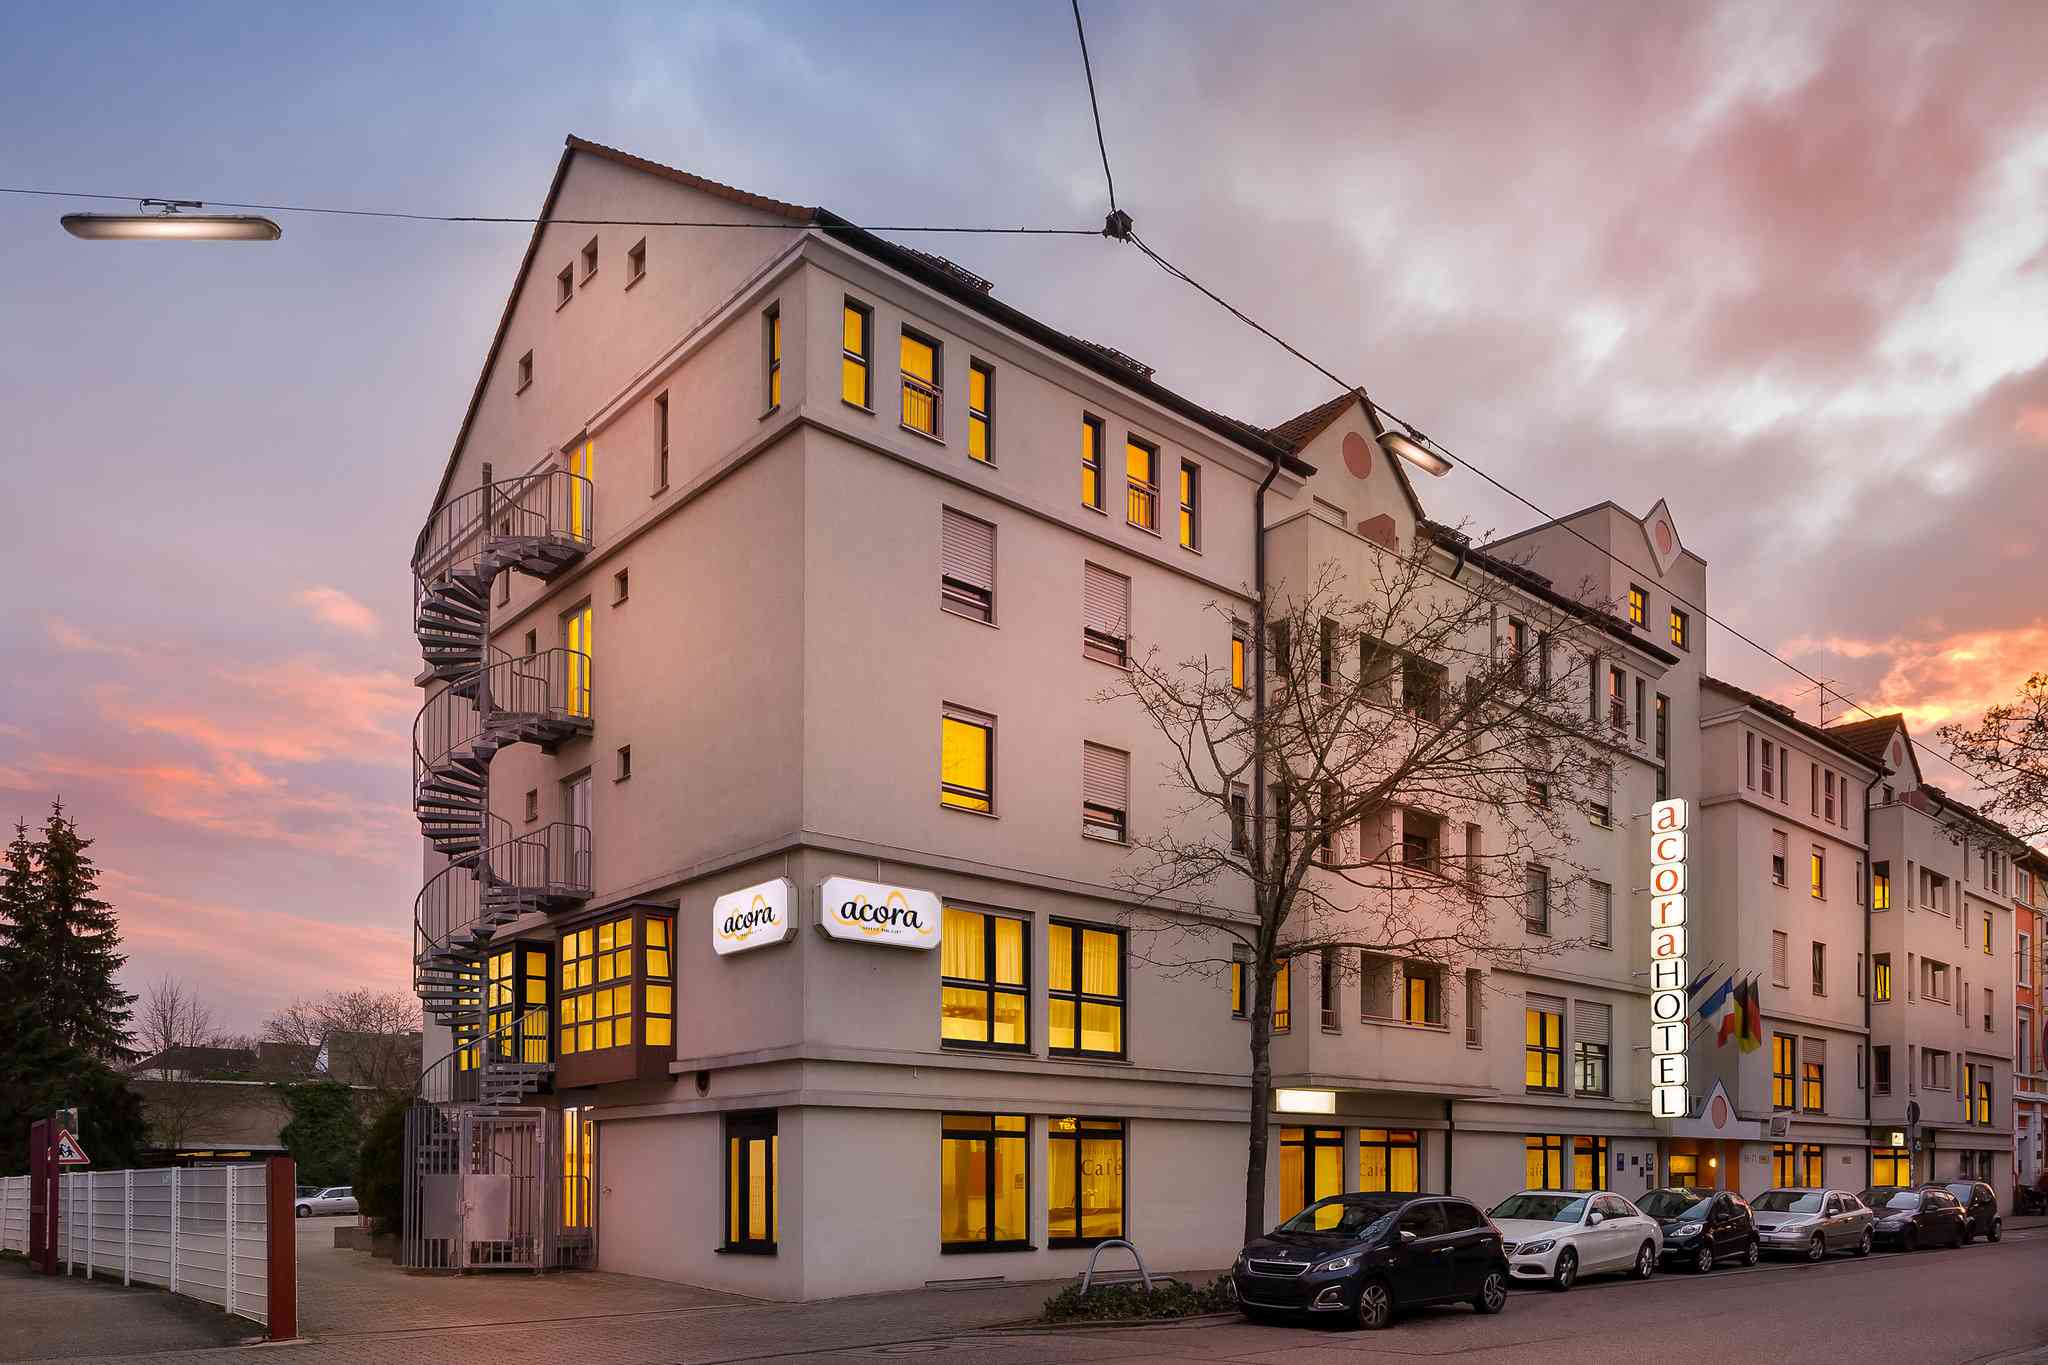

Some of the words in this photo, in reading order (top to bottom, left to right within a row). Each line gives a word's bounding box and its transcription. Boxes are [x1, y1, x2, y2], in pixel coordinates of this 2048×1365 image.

[723, 905, 776, 934] acora
[839, 900, 924, 930] acora
[1654, 805, 1679, 957] acora
[1654, 961, 1681, 1115] HOTEL
